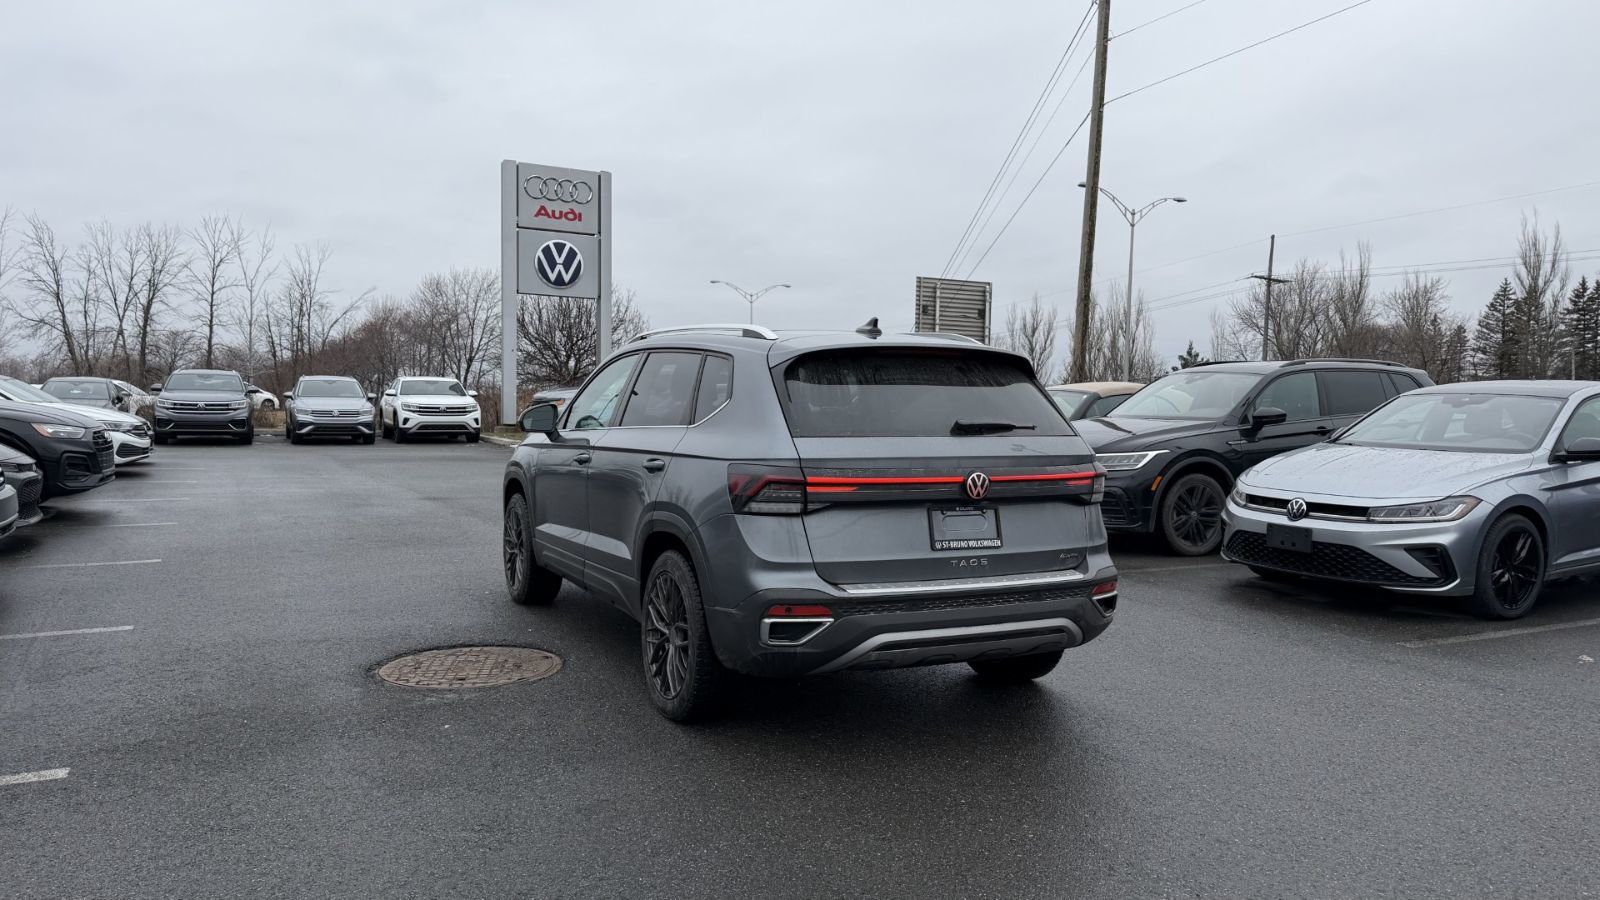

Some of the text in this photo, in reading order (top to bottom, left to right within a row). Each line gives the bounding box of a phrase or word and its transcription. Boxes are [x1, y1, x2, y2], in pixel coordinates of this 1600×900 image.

[534, 205, 583, 222] Audi
[535, 239, 584, 289] VW
[942, 541, 968, 549] ST-BRUNO
[968, 540, 1002, 548] VOLKSWAGEN
[949, 558, 988, 567] TAOS
